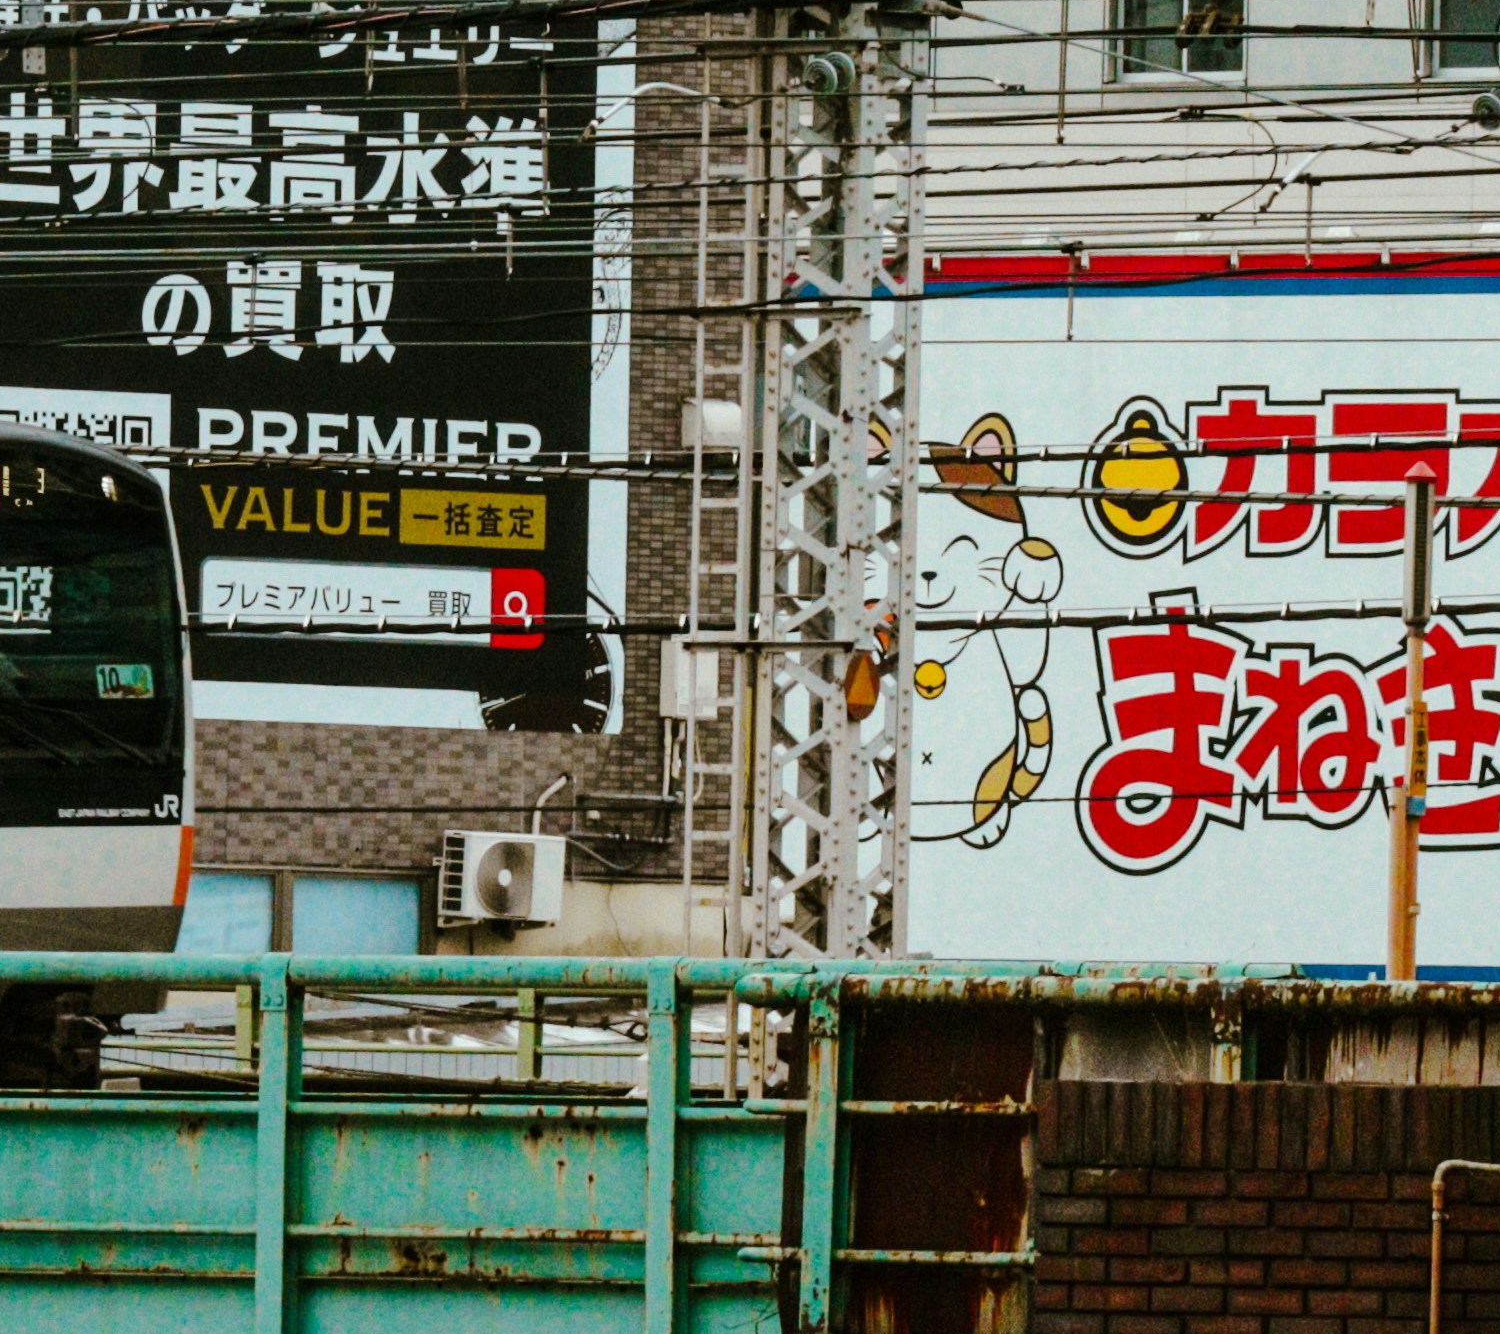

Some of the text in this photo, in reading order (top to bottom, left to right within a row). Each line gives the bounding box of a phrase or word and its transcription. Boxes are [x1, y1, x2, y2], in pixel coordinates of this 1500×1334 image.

[141, 260, 397, 365] の買取
[196, 407, 545, 483] PREMIER
[200, 483, 391, 539] VALUE
[412, 501, 536, 540] 一括査定
[216, 581, 472, 618] プレミアバリュー 買取
[154, 793, 180, 819] JR
